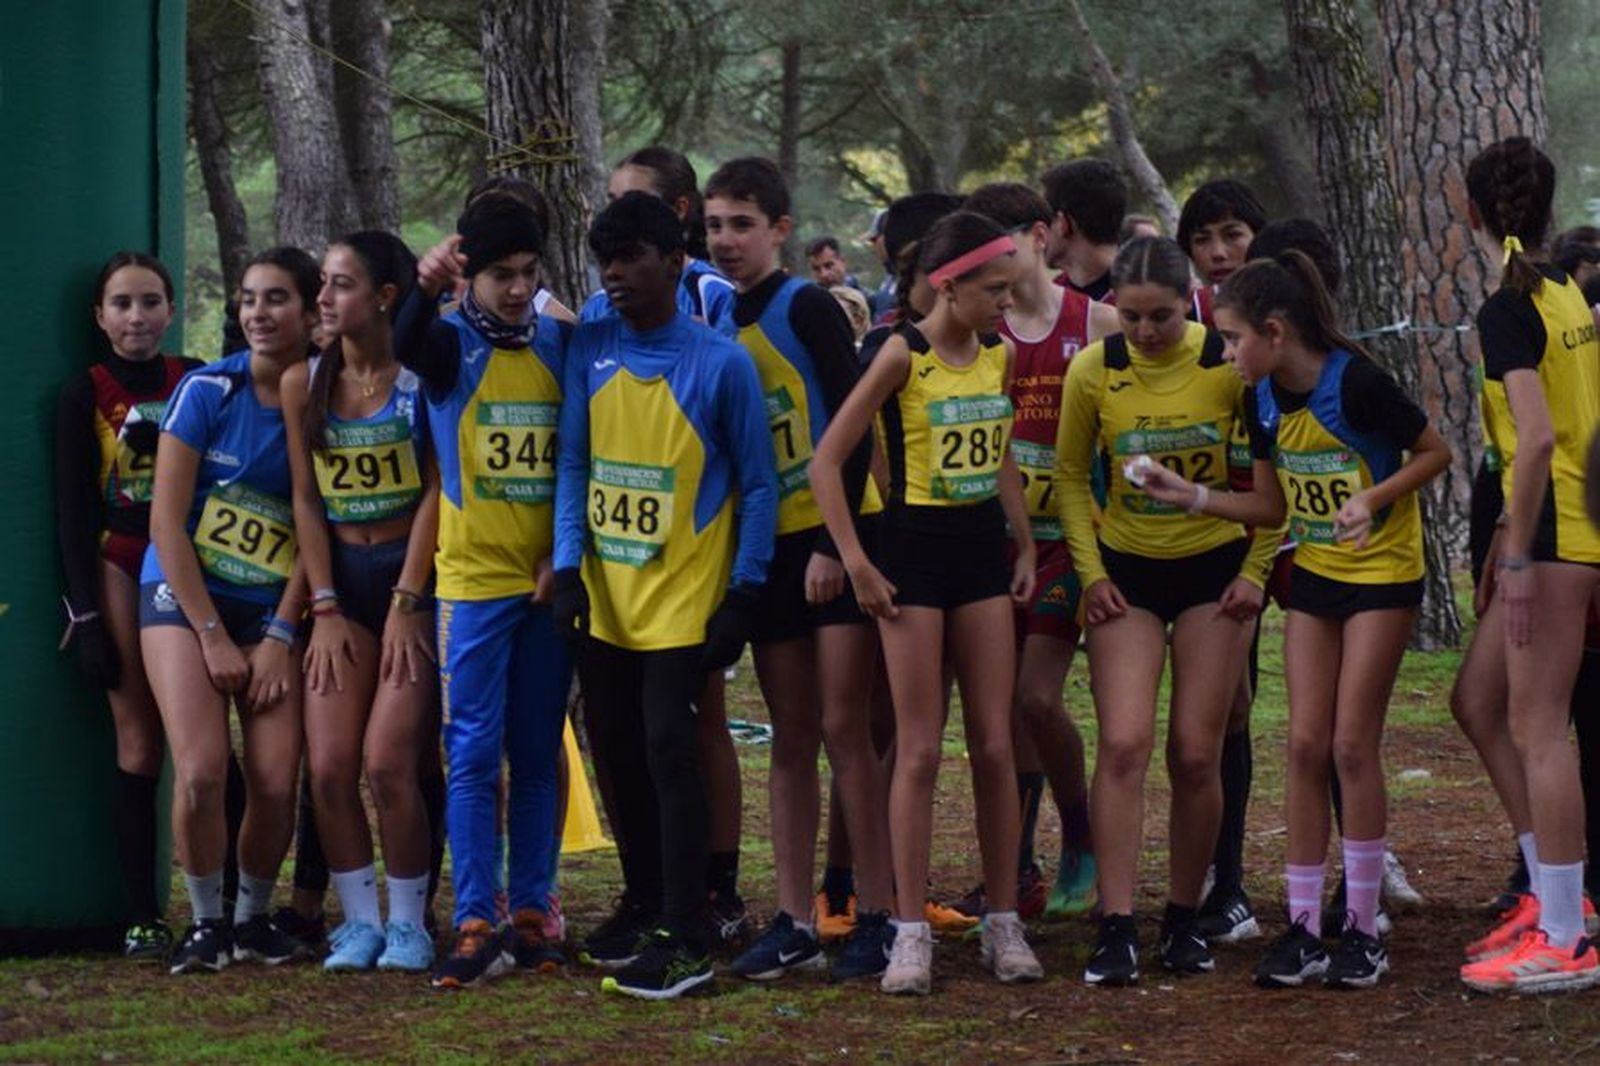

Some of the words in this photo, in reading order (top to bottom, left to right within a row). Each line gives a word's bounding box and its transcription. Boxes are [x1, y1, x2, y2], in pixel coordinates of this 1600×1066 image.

[487, 431, 557, 471] 344
[942, 424, 1002, 469] 289
[328, 449, 403, 490] 291
[593, 489, 660, 536] 348
[1289, 476, 1351, 516] 286
[209, 507, 290, 565] 297
